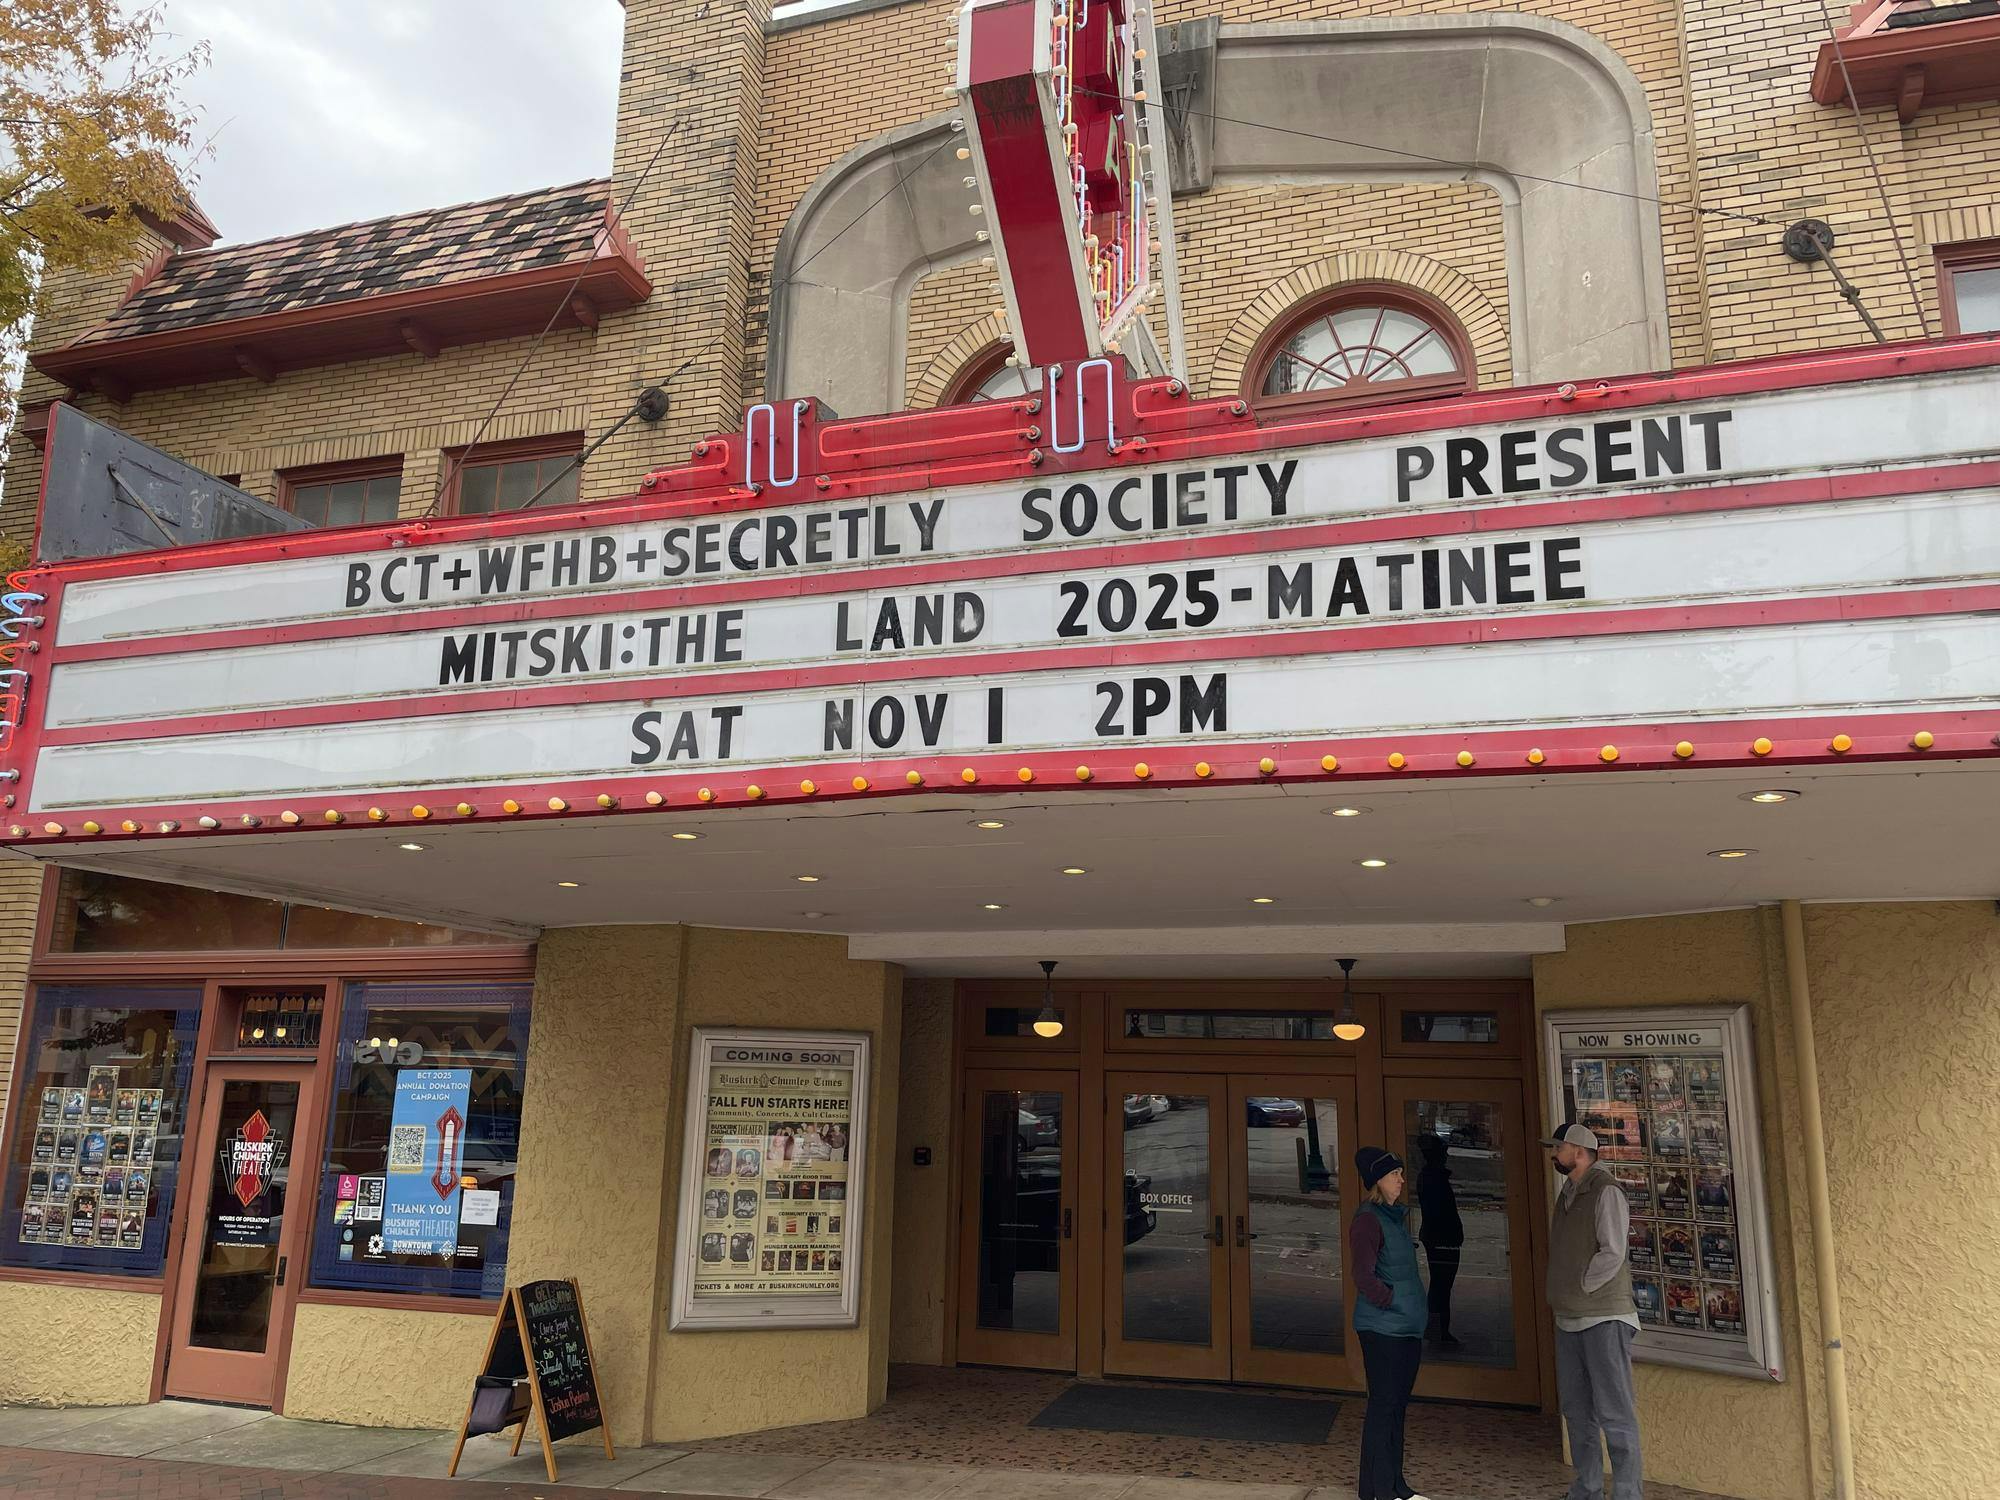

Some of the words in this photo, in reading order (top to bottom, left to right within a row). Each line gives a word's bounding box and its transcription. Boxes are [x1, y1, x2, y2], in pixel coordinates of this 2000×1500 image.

[1021, 459, 1299, 542] SOCIETY
[1397, 409, 1733, 503] PRESENT
[440, 609, 744, 686] MITSKI:THE
[835, 591, 985, 652] LAND
[1056, 536, 1586, 638] 2025-MATINEE
[631, 705, 743, 765] SAT
[823, 693, 949, 752] NOV
[1094, 672, 1227, 737] 2PM
[1578, 1035, 1609, 1047] NOW
[1624, 1033, 1701, 1046] SHOWING
[726, 1050, 793, 1062] COMING
[800, 1053, 841, 1063] SOON
[770, 1075, 810, 1087] Chumley
[813, 1077, 843, 1087] Times
[709, 1096, 737, 1107] FALL
[741, 1097, 764, 1108] FUN
[768, 1098, 811, 1109] STARTS
[814, 1099, 849, 1110] HERE!
[708, 1110, 753, 1118] Community,
[756, 1110, 792, 1119] Concerts,
[737, 1125, 763, 1135] THEATER
[234, 1142, 274, 1152] BUSKIRK
[233, 1151, 273, 1161] CHUMLEY
[232, 1160, 271, 1175] THEATER
[1140, 1193, 1159, 1203] BOX
[1161, 1194, 1192, 1205] OFFICE
[391, 1203, 426, 1214] THANK
[429, 1204, 452, 1215] YOU
[385, 1218, 420, 1227] BUSKIRK
[420, 1219, 455, 1237] THEATER
[385, 1227, 420, 1236] CHUMLEY
[393, 1240, 432, 1249] DOWNTOWN
[391, 1248, 432, 1256] BLOOMINGTON
